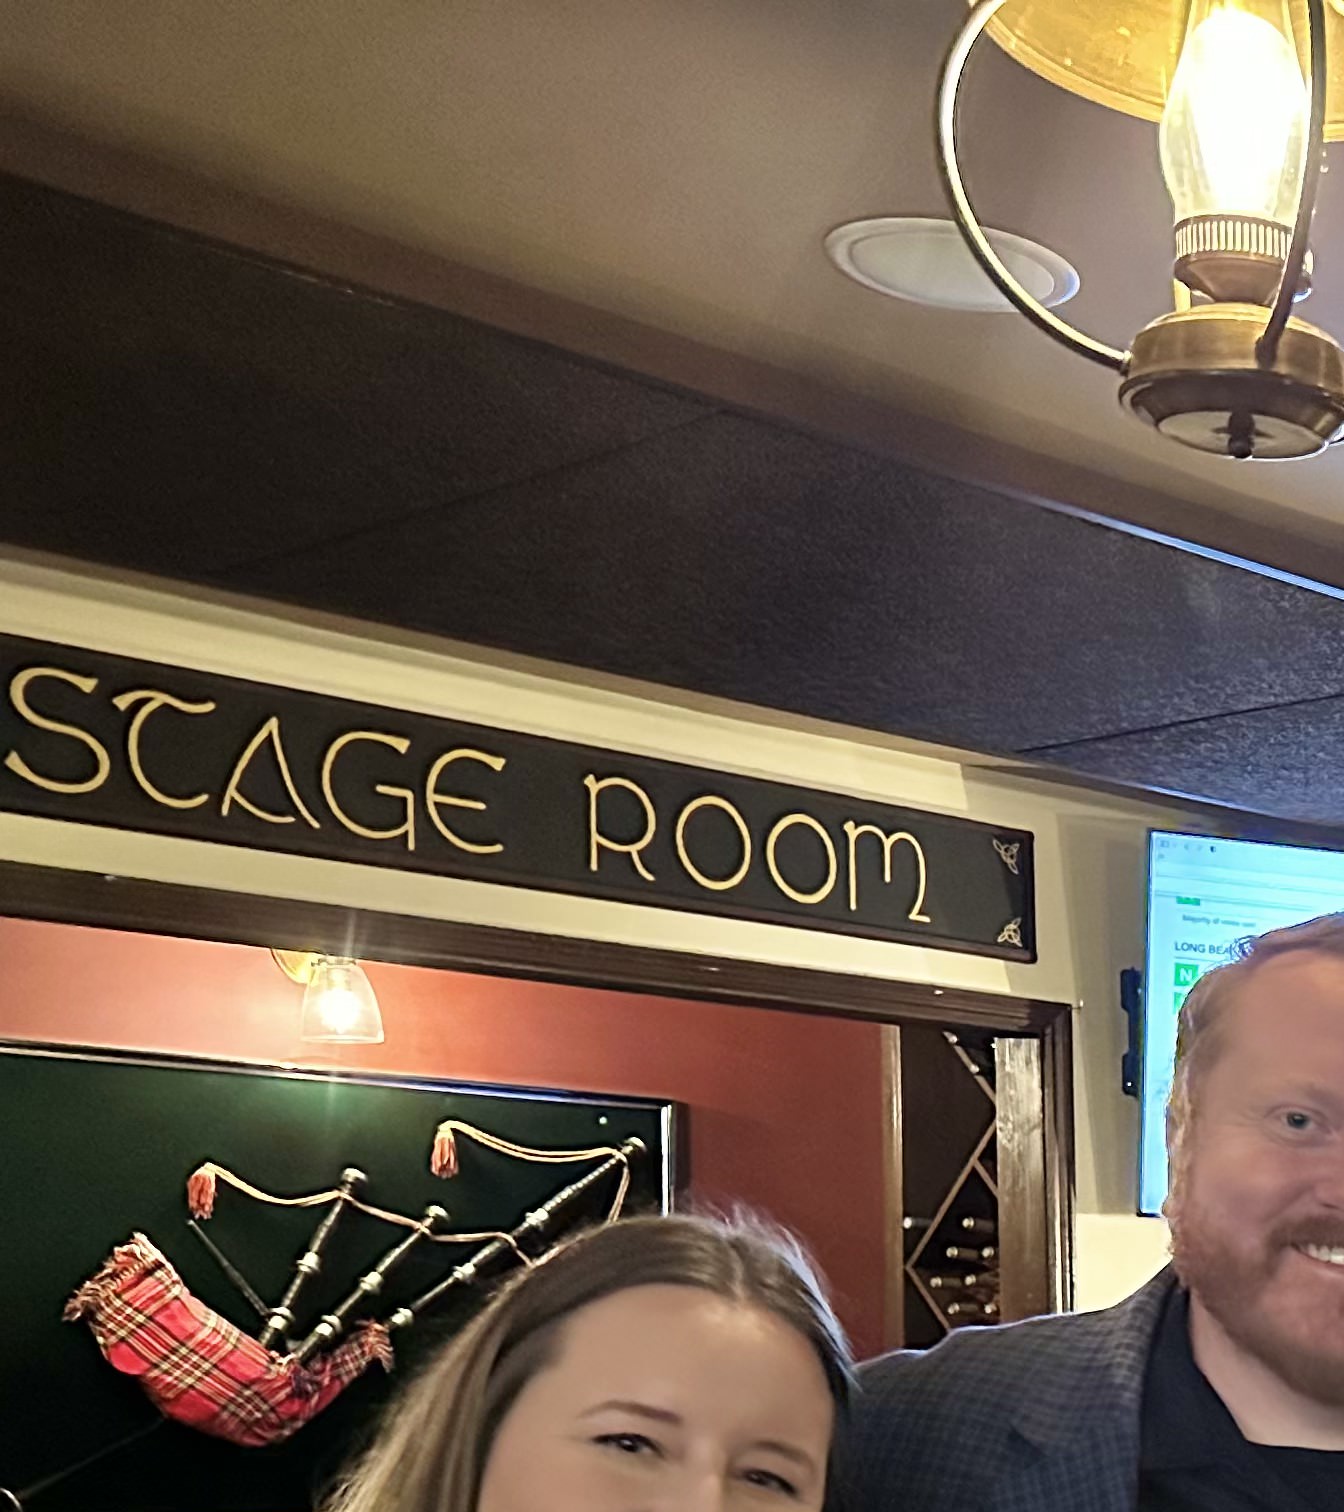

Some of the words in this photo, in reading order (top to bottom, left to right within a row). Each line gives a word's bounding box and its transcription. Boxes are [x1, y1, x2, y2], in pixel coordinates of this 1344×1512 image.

[4, 666, 506, 855] STAGE
[583, 773, 931, 923] ROOM
[1174, 941, 1206, 954] LONG
[1208, 944, 1232, 956] BEA
